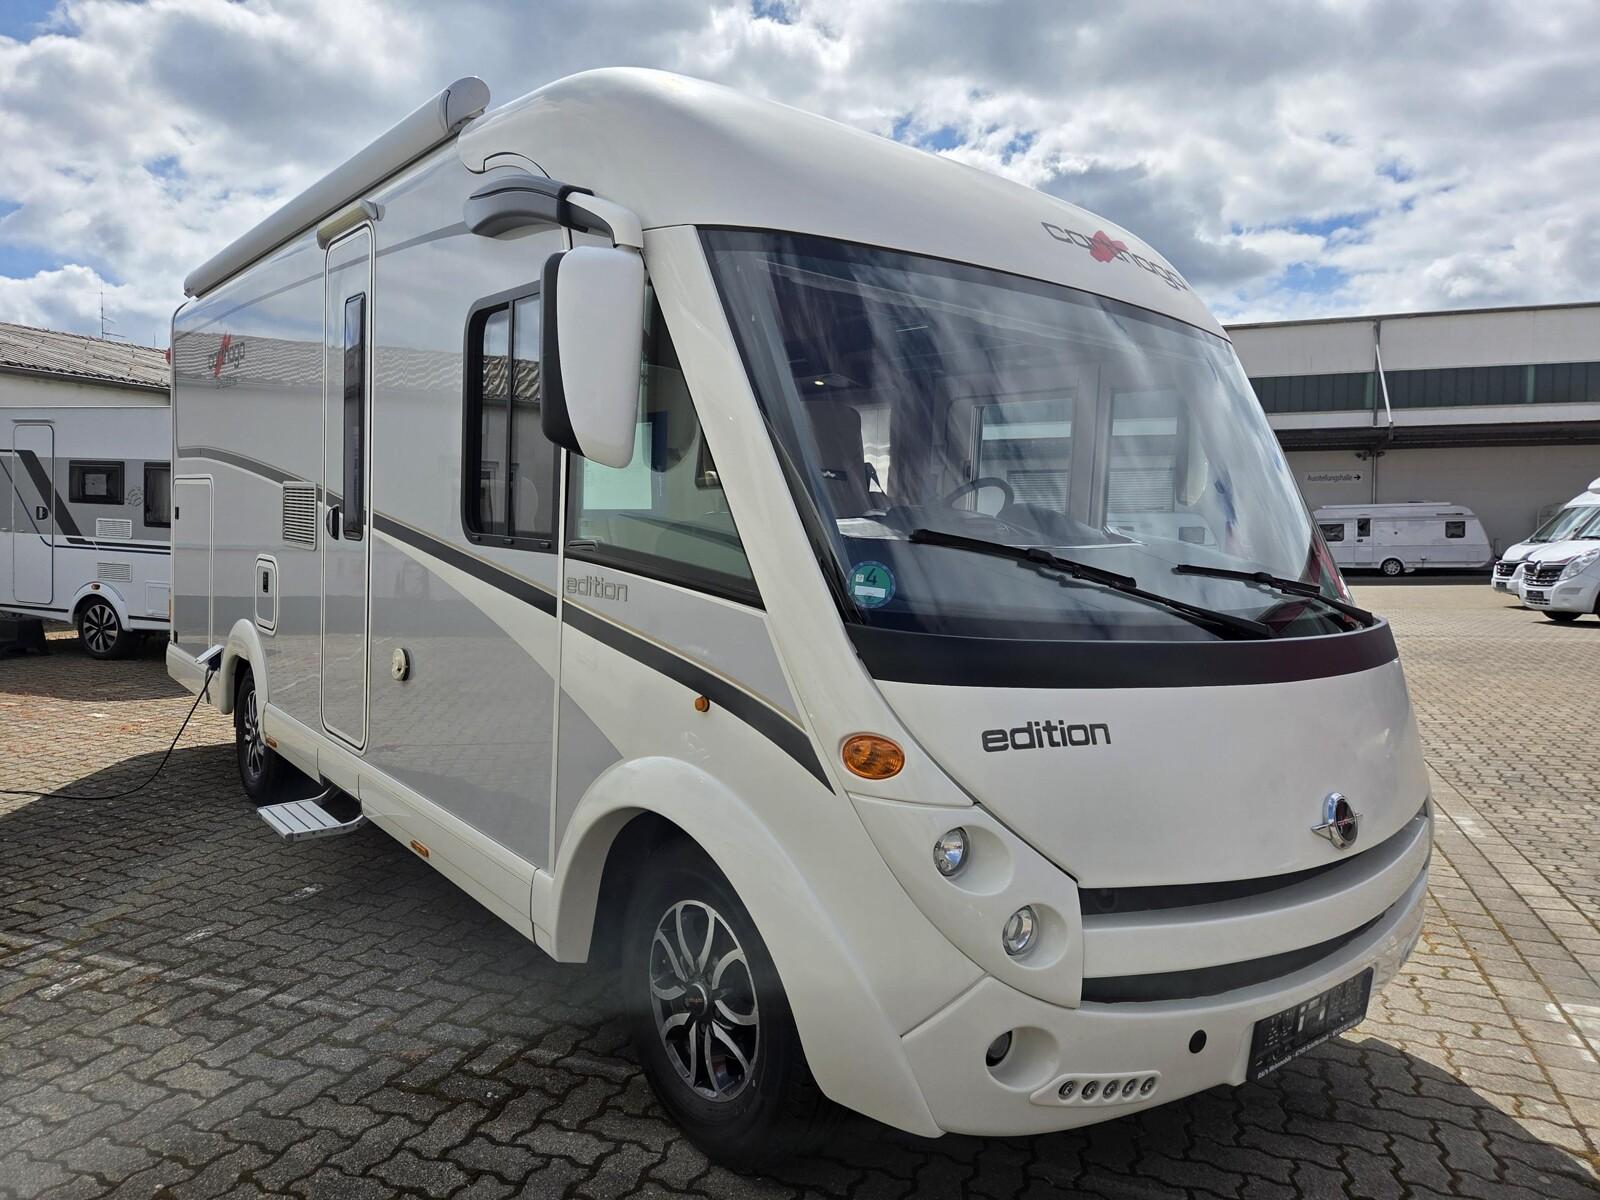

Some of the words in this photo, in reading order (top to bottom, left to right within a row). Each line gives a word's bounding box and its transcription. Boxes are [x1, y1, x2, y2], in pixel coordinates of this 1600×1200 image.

[566, 575, 628, 602] edition
[866, 568, 878, 586] 4
[981, 720, 1112, 753] edition
